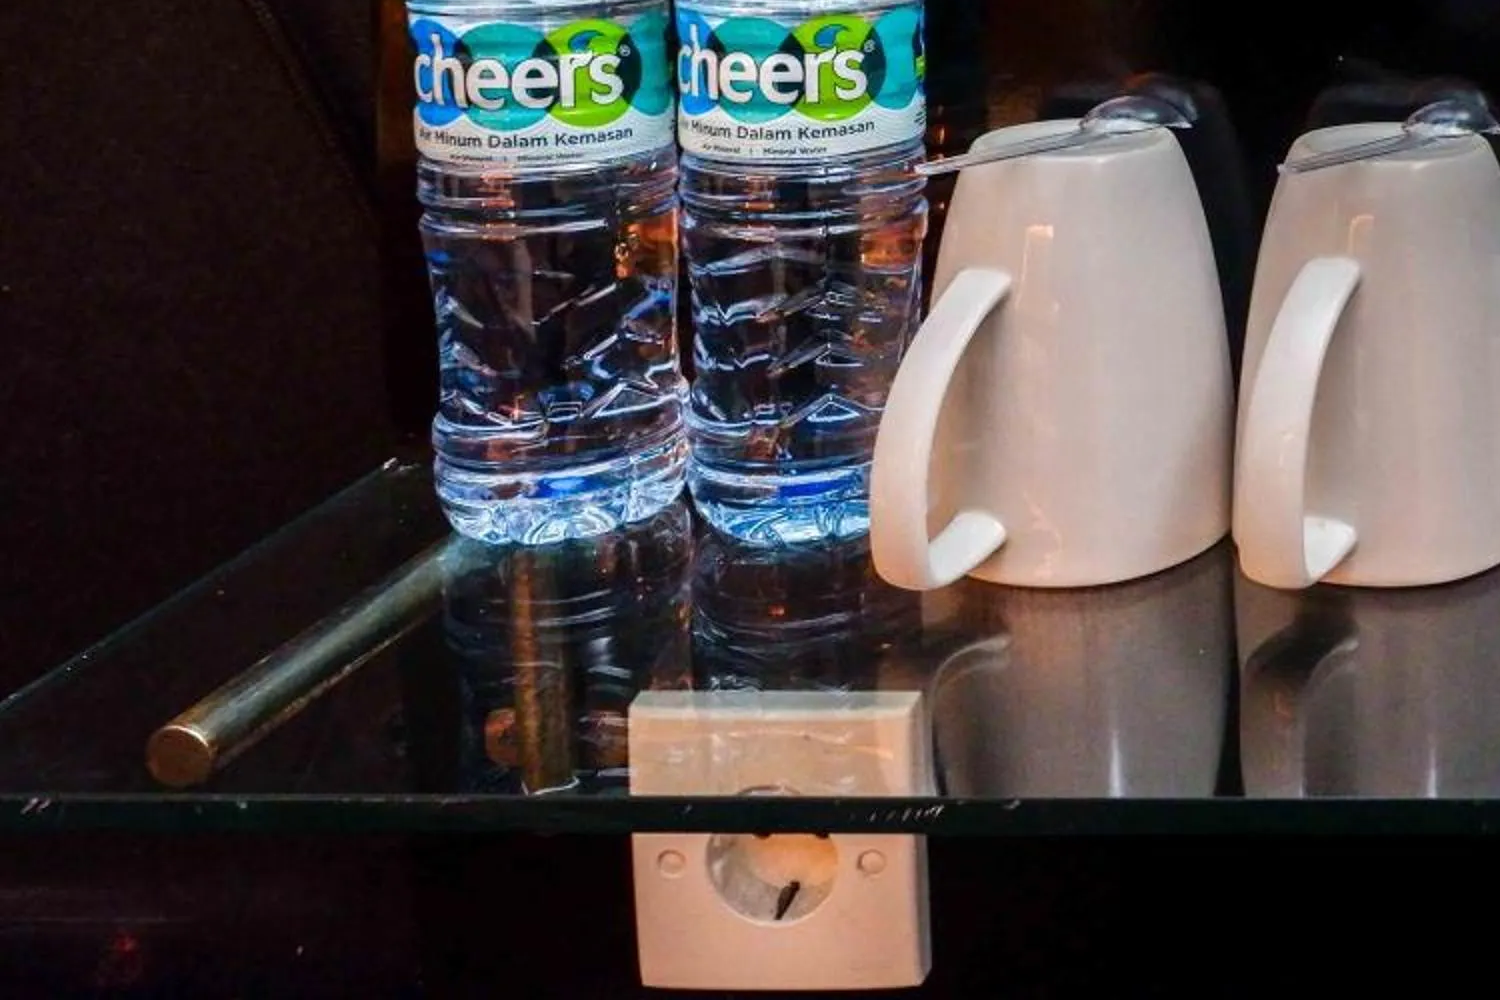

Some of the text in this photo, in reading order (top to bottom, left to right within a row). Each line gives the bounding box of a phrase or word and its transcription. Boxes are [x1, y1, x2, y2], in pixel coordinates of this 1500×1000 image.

[414, 34, 624, 109] cheers
[677, 23, 868, 105] cheers
[434, 130, 482, 148] Minum
[488, 134, 548, 148] Dalam
[555, 128, 633, 147] Kemasan
[737, 126, 792, 140] Dalam
[798, 121, 875, 140] Kemasan
